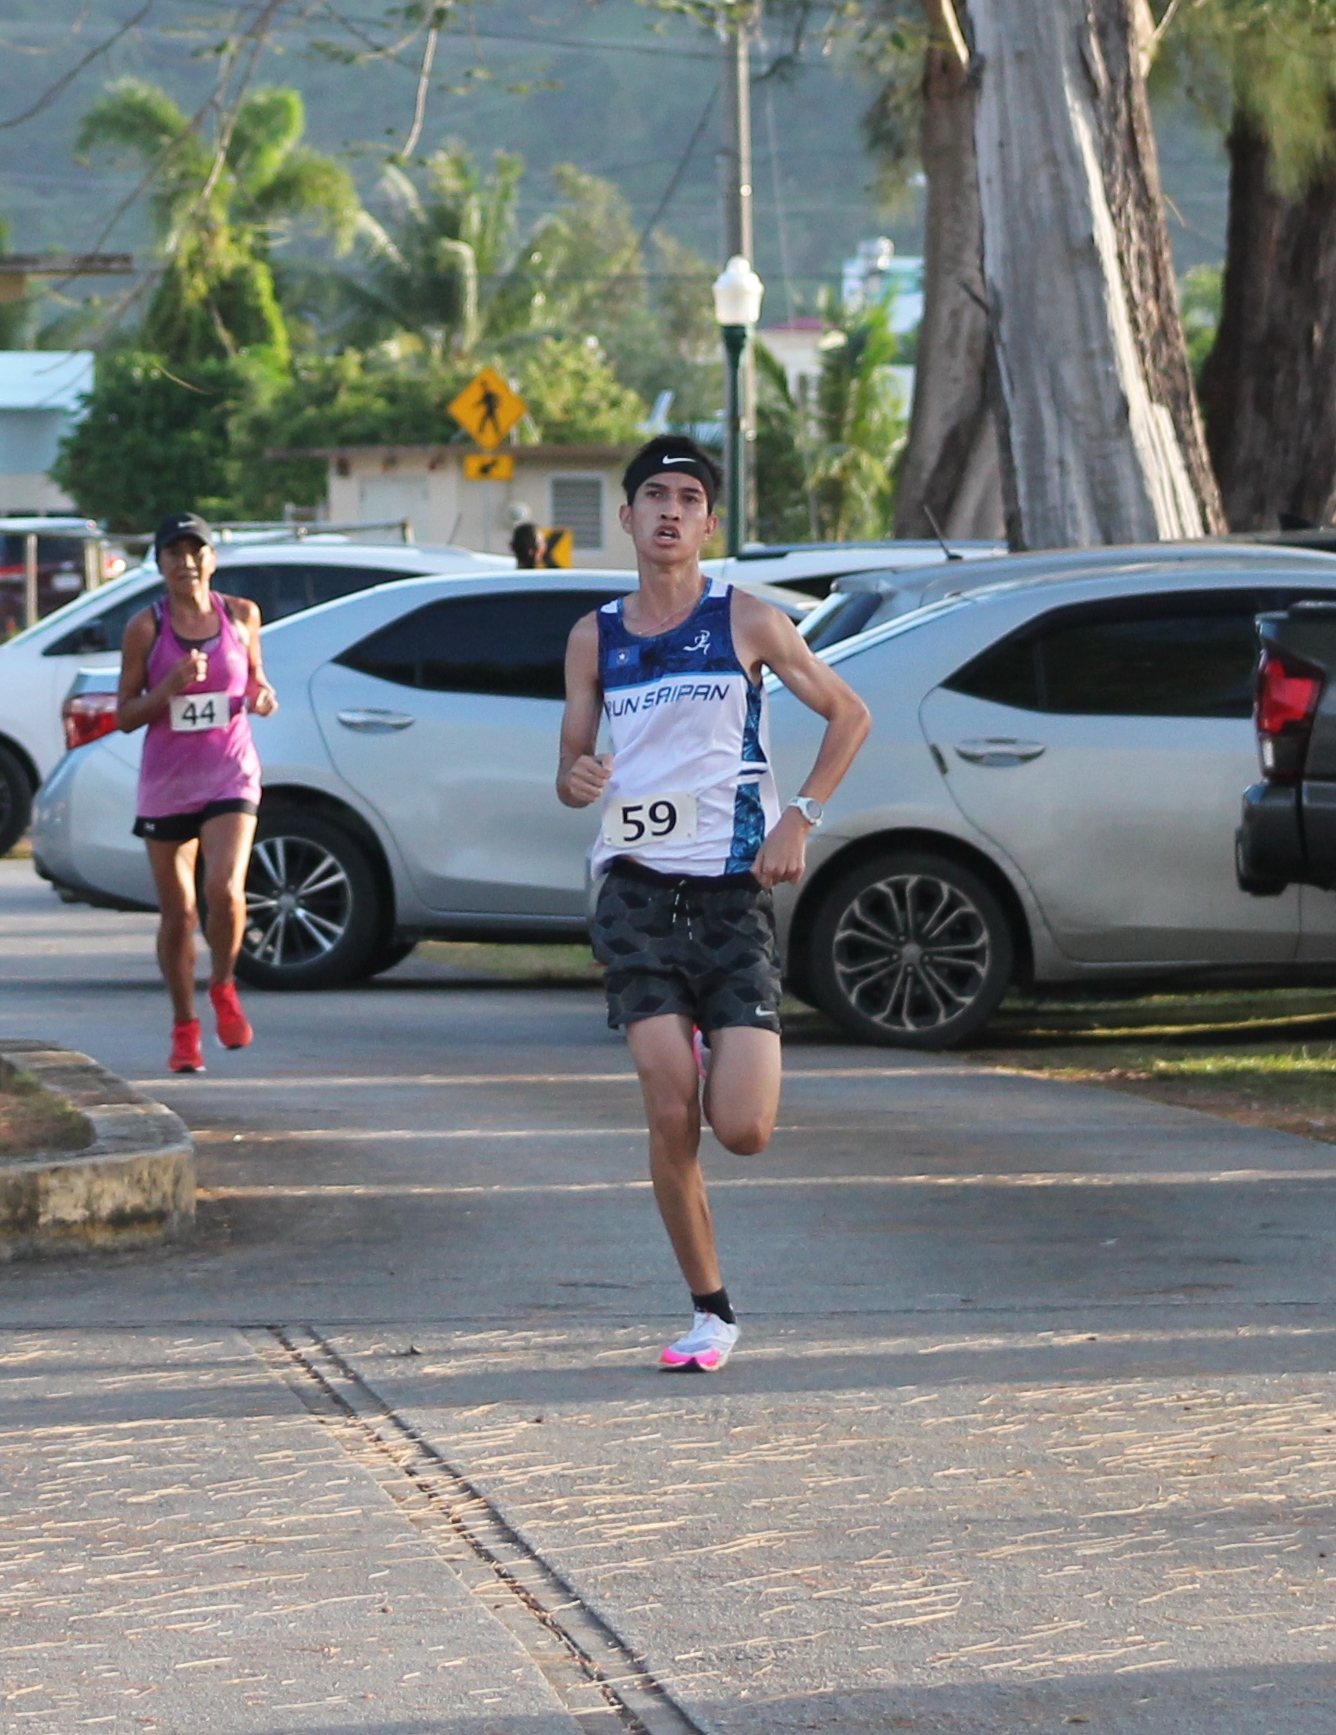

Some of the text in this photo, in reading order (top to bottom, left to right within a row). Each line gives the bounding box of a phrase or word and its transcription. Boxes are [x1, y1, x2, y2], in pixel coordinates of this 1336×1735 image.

[642, 684, 730, 709] SAIPAN
[182, 700, 216, 726] 44
[622, 800, 677, 842] 59
